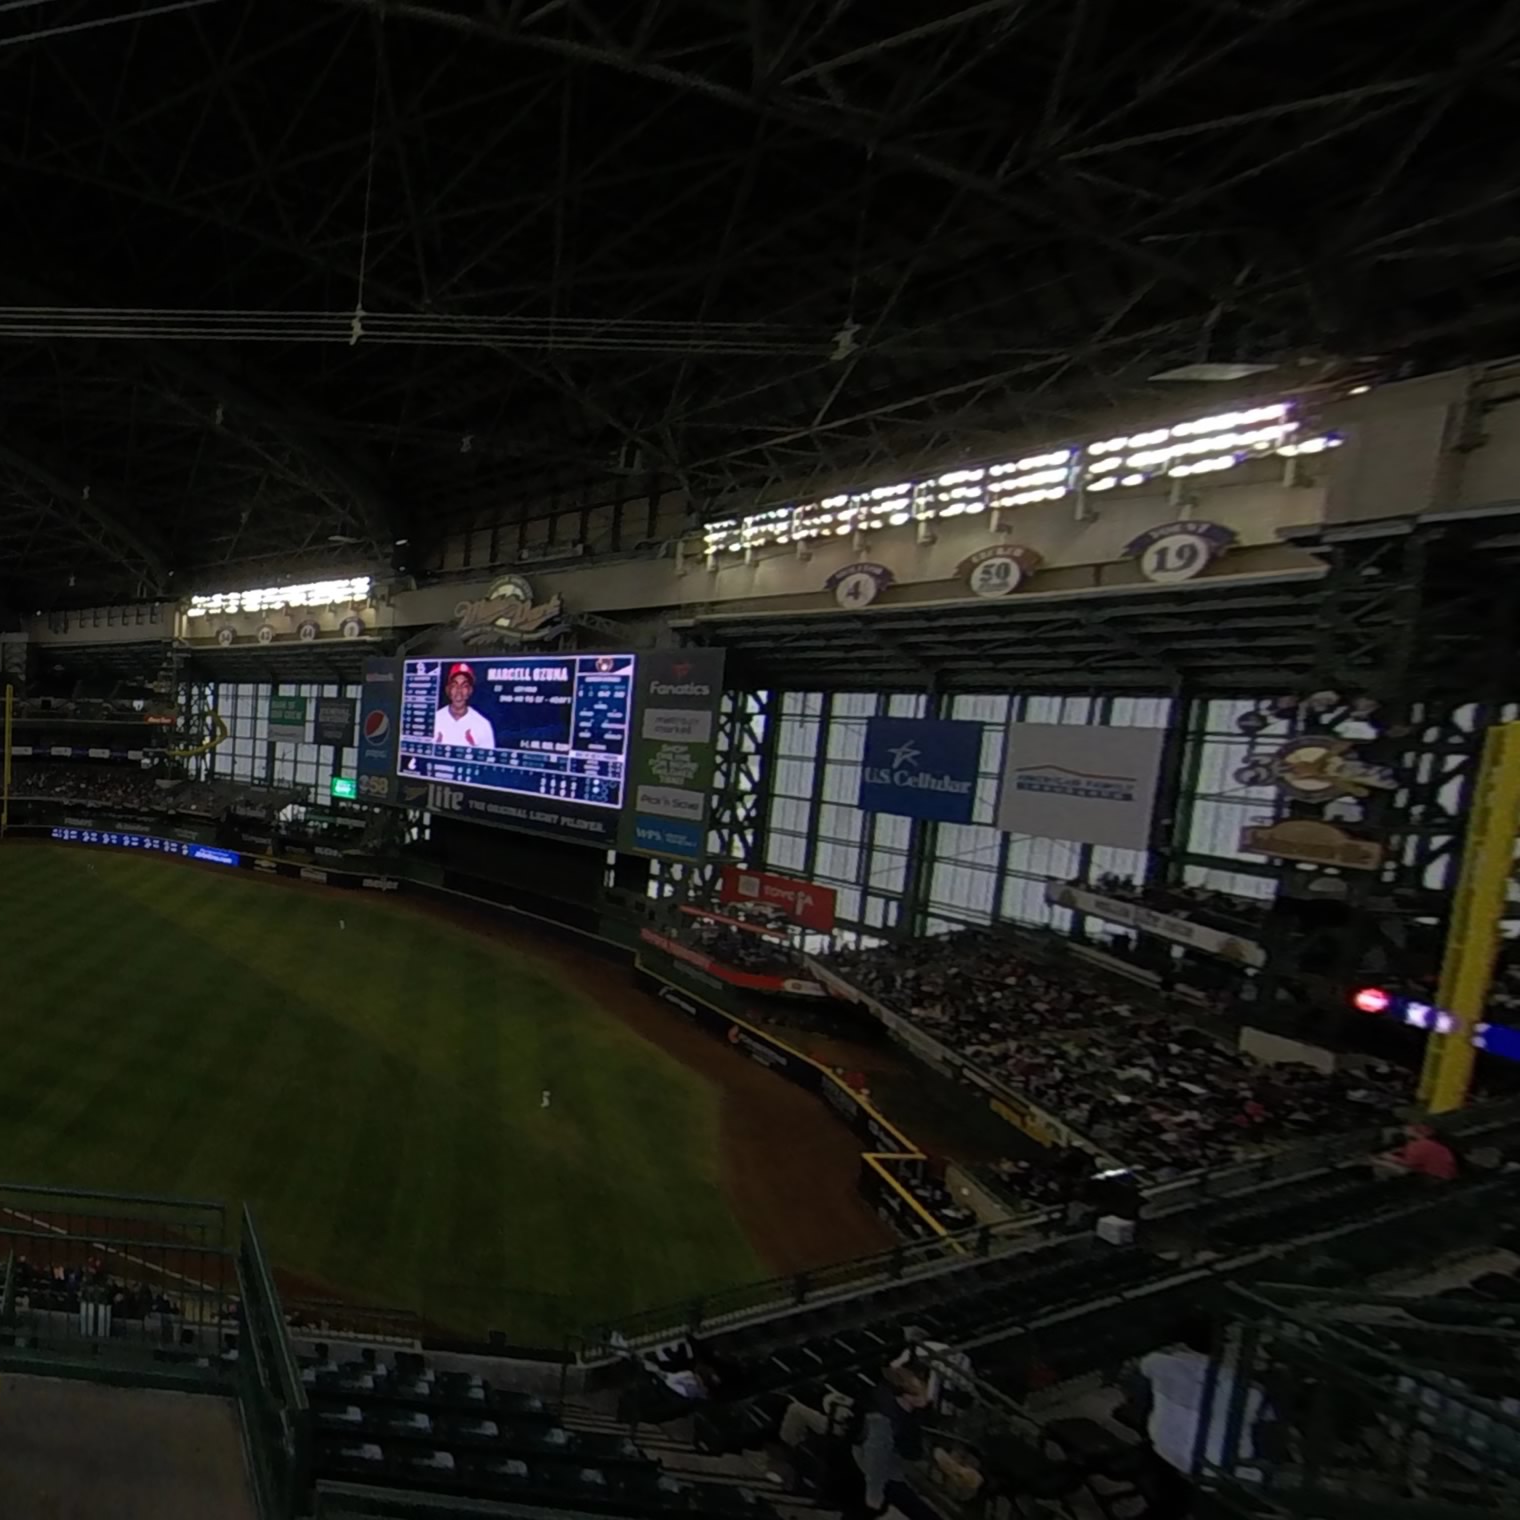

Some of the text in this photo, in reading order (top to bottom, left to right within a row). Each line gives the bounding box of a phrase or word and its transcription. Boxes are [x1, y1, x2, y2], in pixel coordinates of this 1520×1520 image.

[1151, 541, 1199, 573] 19
[979, 561, 1011, 582] 50
[846, 580, 861, 600] 4
[487, 666, 569, 681] MARCELL OZUNA
[650, 681, 710, 696] Fanatics
[892, 769, 973, 795] Cellular
[426, 782, 465, 812] Lite
[468, 799, 486, 812] THE
[486, 804, 529, 820] ORIGINAL
[529, 810, 560, 825] LIGHT
[763, 884, 814, 906] TOYOTA
